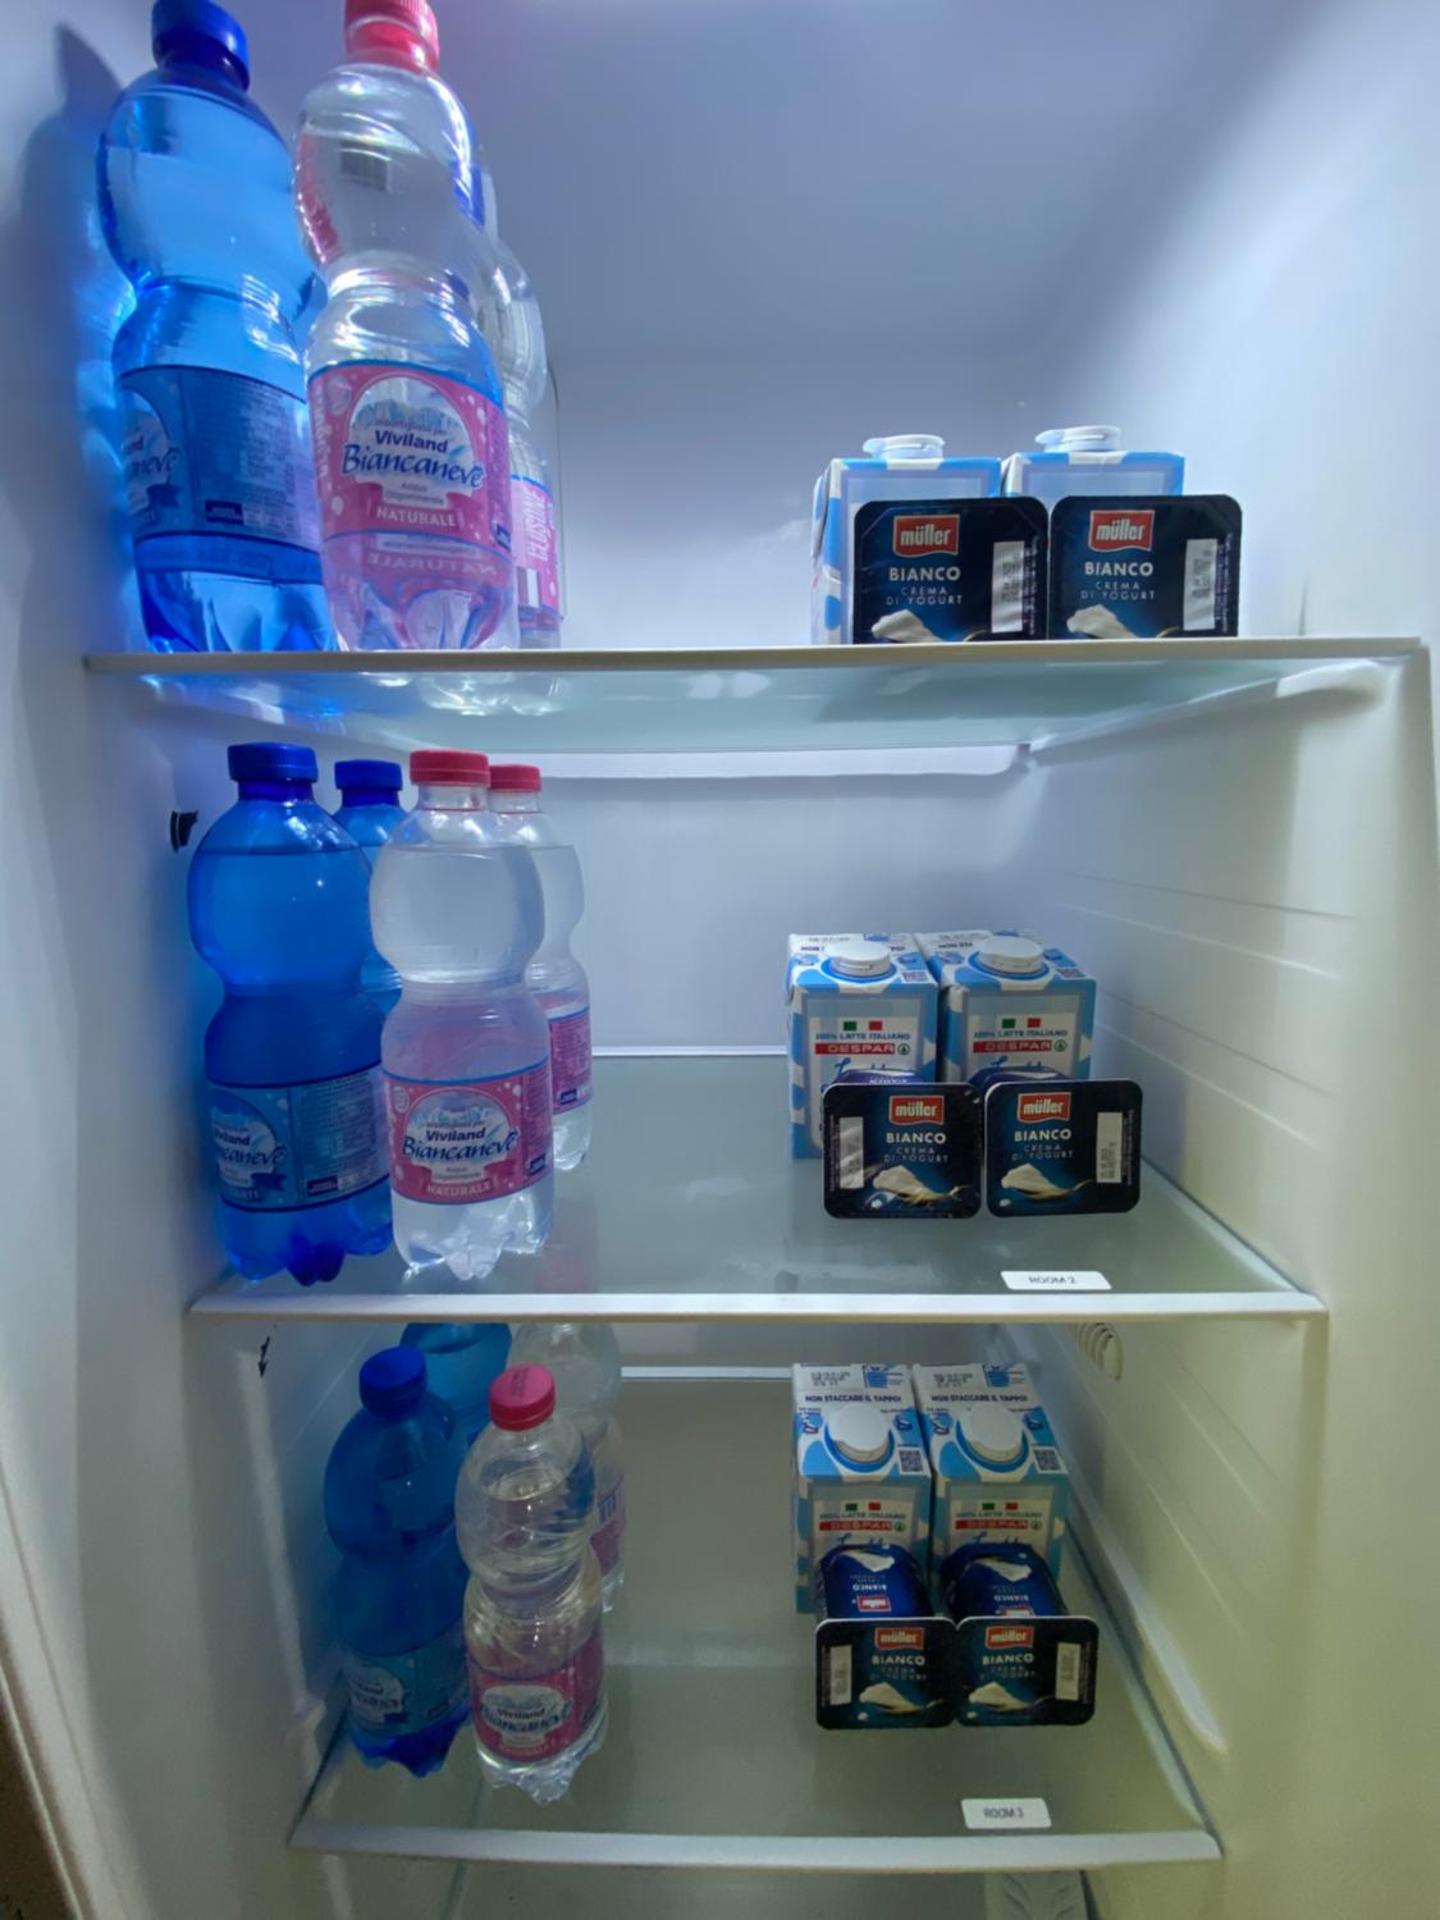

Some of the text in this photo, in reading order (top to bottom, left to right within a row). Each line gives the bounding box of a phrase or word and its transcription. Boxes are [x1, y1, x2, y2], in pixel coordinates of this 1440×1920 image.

[375, 430, 448, 453] Viviland
[342, 444, 483, 488] Biancaneve
[377, 507, 457, 527] NATURALE
[900, 524, 951, 545] müller
[1096, 519, 1145, 541] müller
[889, 567, 961, 581] BIANCO
[1084, 562, 1153, 576] BIANCO
[901, 587, 948, 596] CREMA
[1096, 581, 1140, 590] CREMA
[886, 595, 963, 606] DI YOGURT
[1081, 590, 1155, 600] DI YOGURT
[840, 1032, 866, 1040] LATTE
[827, 1043, 894, 1053] DESPAR
[984, 1040, 1051, 1051] DESPAR
[895, 1101, 937, 1117] müller
[1023, 1098, 1064, 1115] müller
[426, 1128, 486, 1142] Viviland
[886, 1132, 946, 1144] BIANCO
[1014, 1129, 1072, 1142] BIANCO
[403, 1128, 519, 1160] Biancaneve
[427, 1182, 490, 1195] NATURALE
[1028, 1276, 1077, 1284] ROOM 2
[950, 1394, 989, 1402] STACCARE
[830, 1521, 892, 1530] DESPAR
[872, 1655, 926, 1665] BIANCO
[982, 1653, 1034, 1665] BIANCO
[983, 1807, 1015, 1818] ROOM
